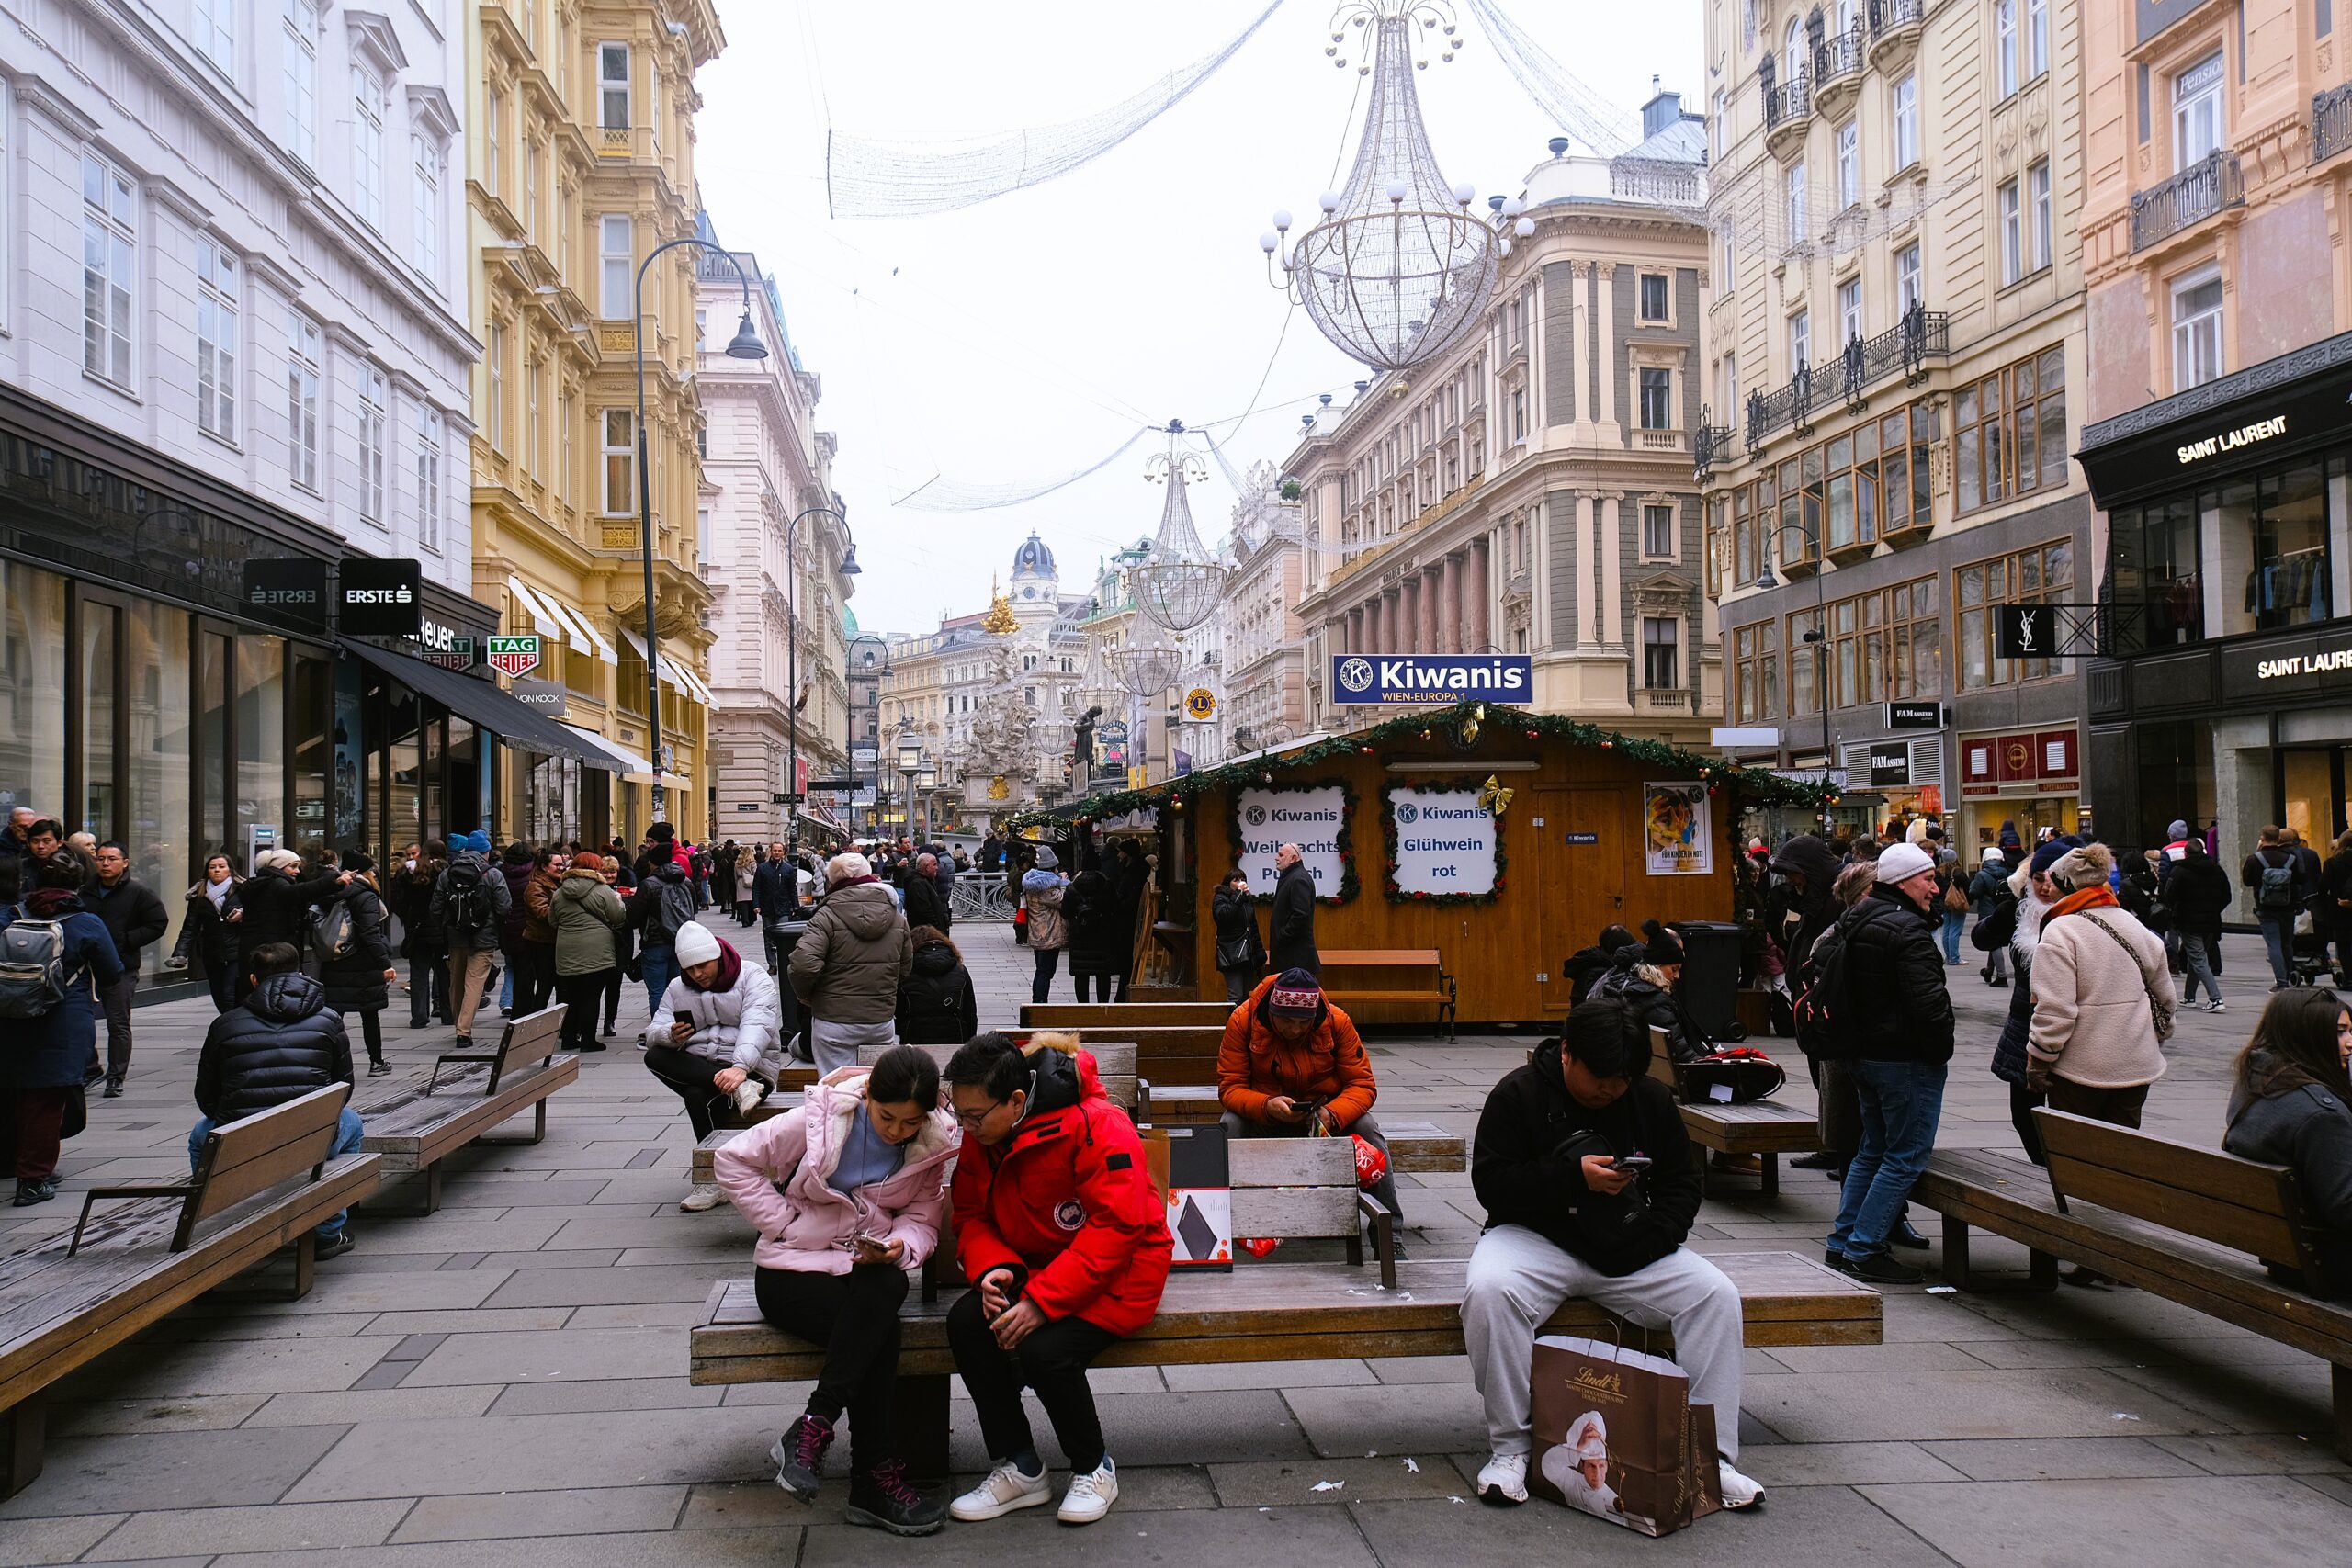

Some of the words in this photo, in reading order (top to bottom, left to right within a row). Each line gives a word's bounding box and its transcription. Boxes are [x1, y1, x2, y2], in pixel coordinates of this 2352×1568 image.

[2177, 437, 2216, 464] SAINT
[2218, 415, 2287, 452] LAURENT
[346, 590, 394, 604] ERSTE
[2018, 610, 2037, 651] YSL
[492, 639, 534, 651] TAG
[492, 654, 535, 674] HEUER
[2257, 657, 2301, 679] SAINT
[1350, 665, 1364, 684] K
[1380, 660, 1523, 689] Kiwanis
[515, 694, 535, 703] VON
[536, 693, 560, 703] KÖCK
[1197, 697, 1205, 709] L
[1382, 693, 1457, 701] WIEN-EUROPA
[1779, 773, 1834, 782] SOUVENIS
[1252, 809, 1261, 821] K
[1271, 808, 1338, 821] Kiwanis
[1403, 807, 1413, 819] K
[1422, 807, 1488, 820] Kiwanis
[1243, 840, 1340, 853] Weihachts
[1404, 837, 1483, 852] Glühwein
[1432, 863, 1457, 877] rot
[1574, 1366, 1612, 1390] Lindt
[1674, 1475, 1686, 1515] Lindt
[1697, 1477, 1709, 1509] Lindt
